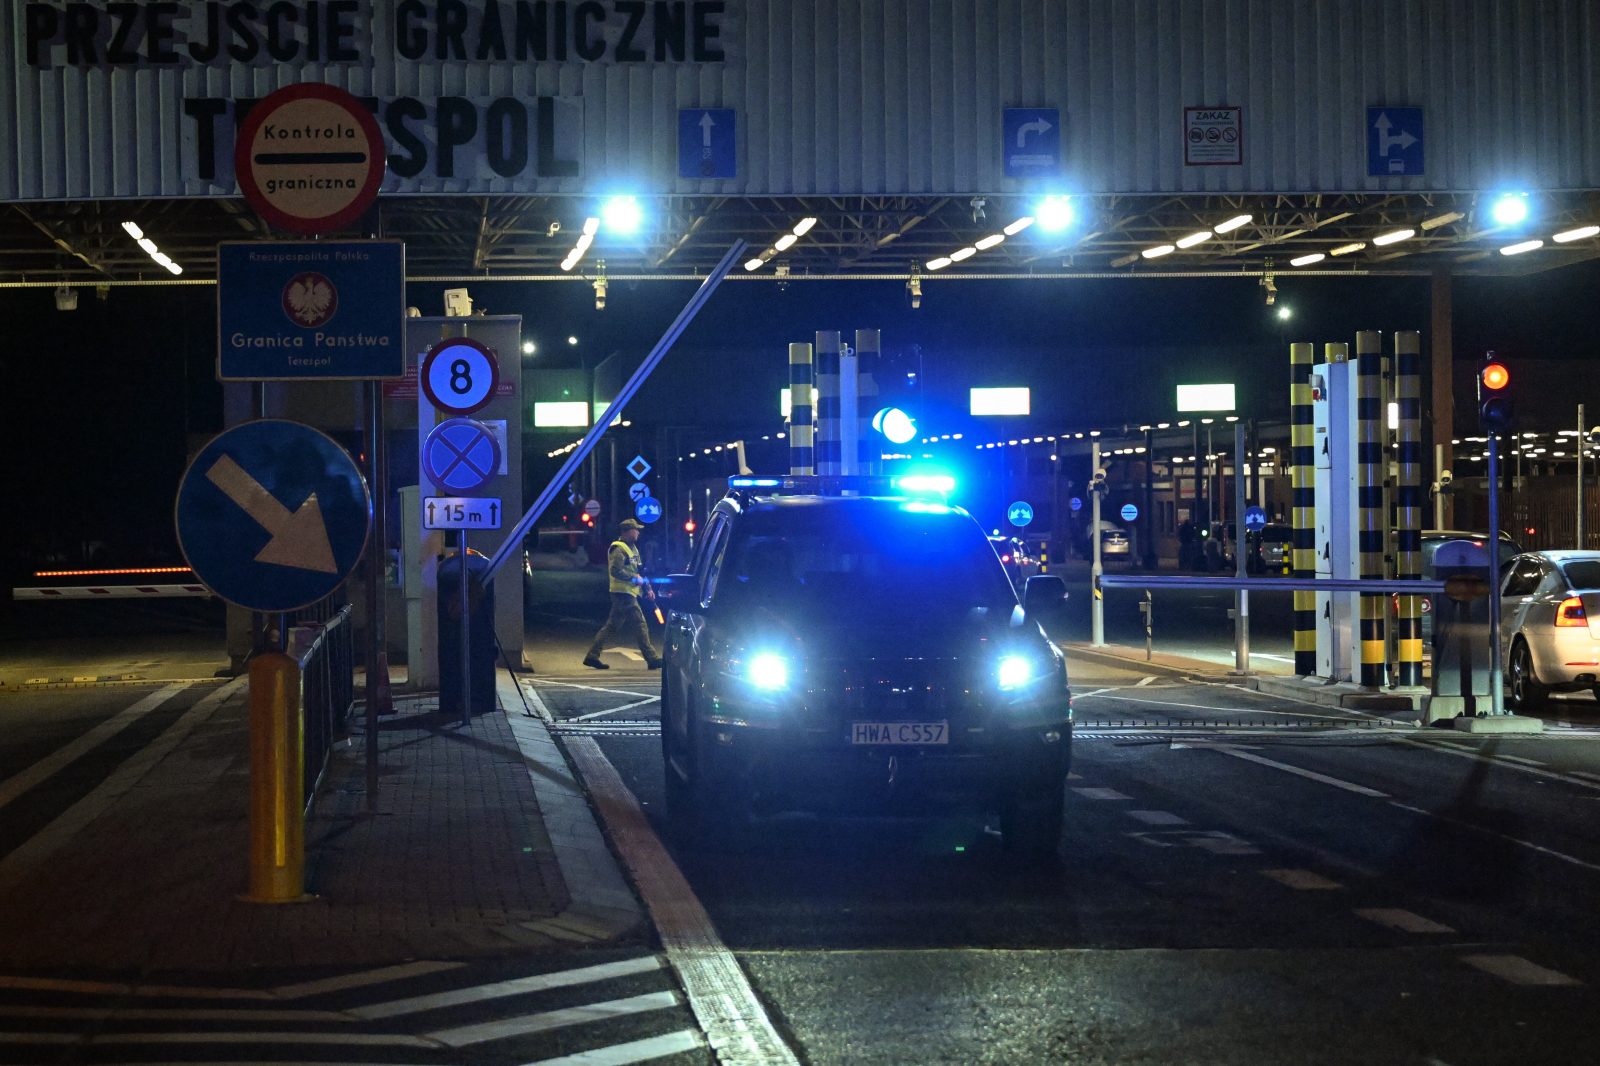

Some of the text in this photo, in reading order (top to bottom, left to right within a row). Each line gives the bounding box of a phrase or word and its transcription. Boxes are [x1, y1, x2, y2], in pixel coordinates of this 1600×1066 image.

[397, 0, 724, 62] GRANICZNE
[1196, 111, 1231, 121] ZAKAZ
[184, 97, 579, 178] TSPOL
[264, 123, 356, 139] Kontrola
[266, 174, 356, 193] graniczna
[231, 332, 304, 348] Granica
[287, 356, 331, 367] Terespol
[450, 359, 472, 394] 8
[444, 504, 481, 522] 15 m
[856, 724, 945, 742] HWA C557
